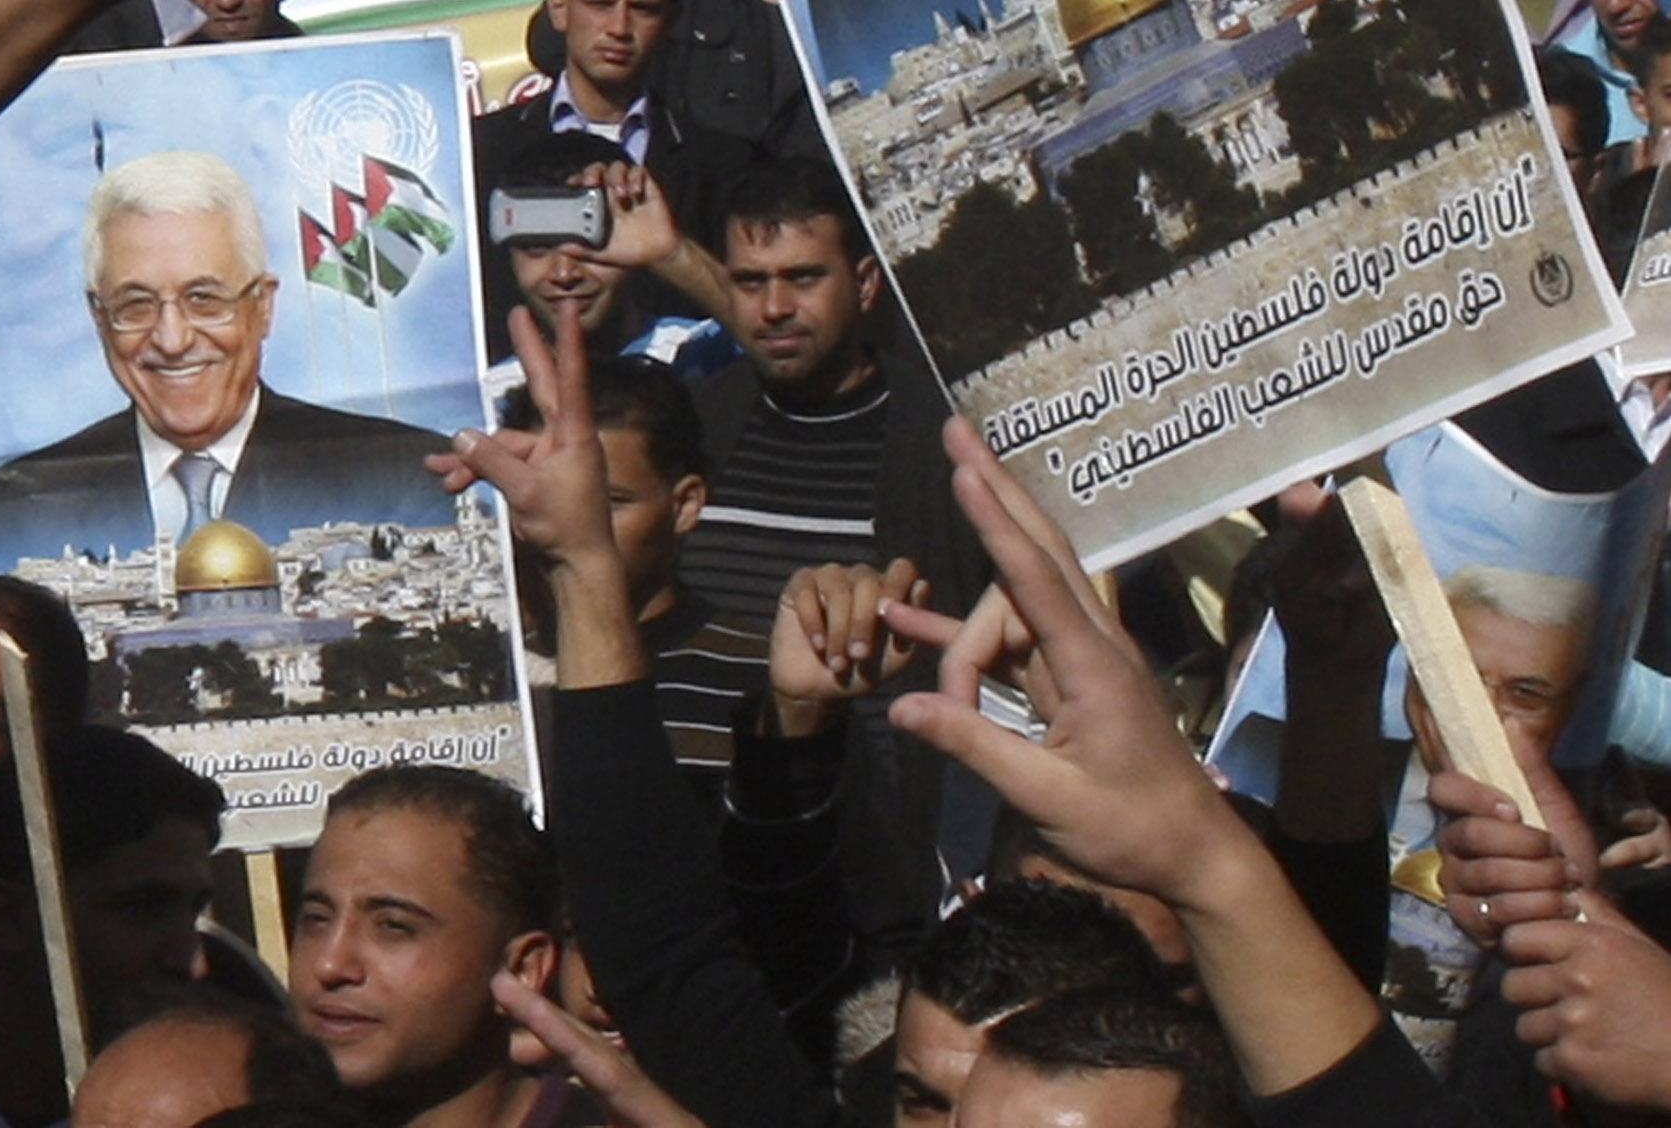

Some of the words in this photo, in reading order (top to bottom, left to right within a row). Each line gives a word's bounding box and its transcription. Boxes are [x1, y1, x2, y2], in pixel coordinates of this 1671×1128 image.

[1404, 191, 1490, 265] إقامة
[1335, 244, 1395, 297] دولة
[1460, 274, 1503, 326] حق
[1206, 276, 1325, 366] فلسطين
[1358, 294, 1449, 373] مقدس
[1128, 331, 1195, 398] الحرة
[1243, 336, 1346, 421] للشعب
[985, 367, 1118, 456] المستقلة
[202, 747, 314, 779] فلسطين
[324, 745, 380, 772] دولة
[390, 735, 464, 765] إقامة
